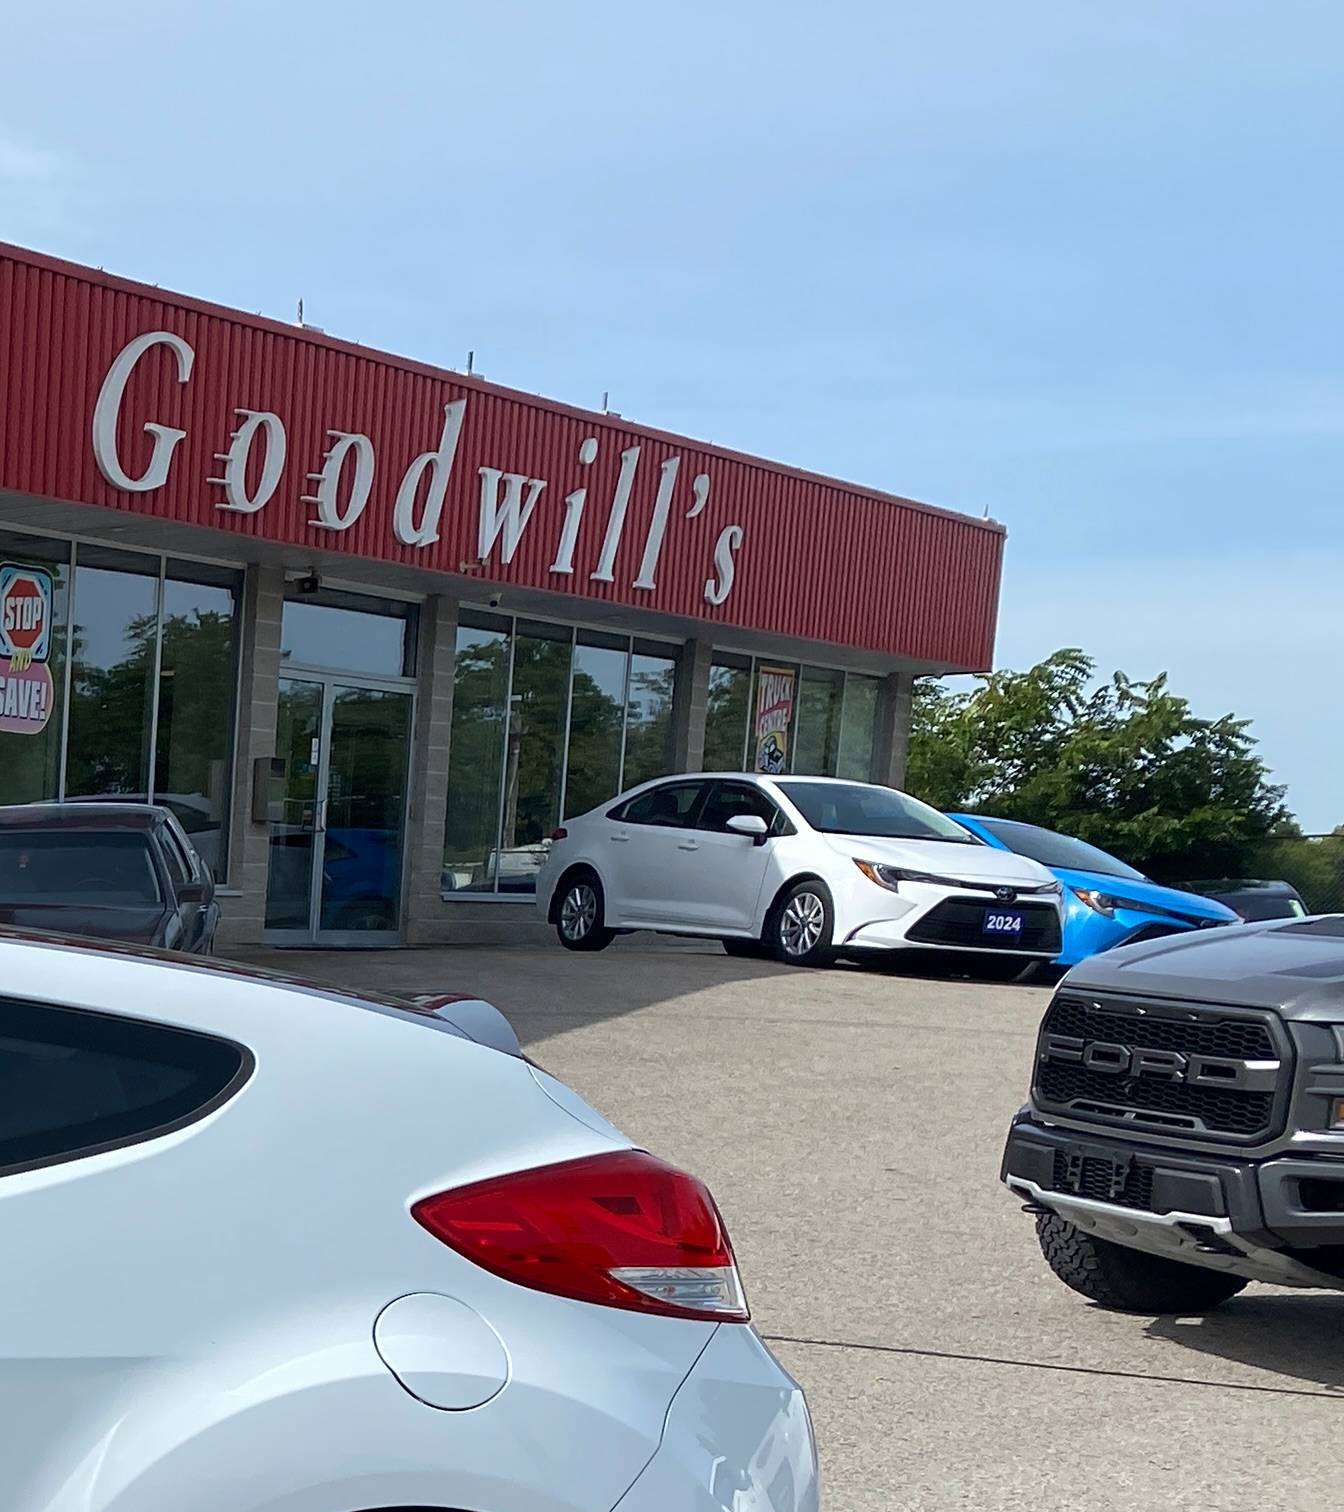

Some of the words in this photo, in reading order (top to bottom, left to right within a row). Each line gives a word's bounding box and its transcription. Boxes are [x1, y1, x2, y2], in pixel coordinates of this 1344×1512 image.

[92, 331, 744, 605] Goodwill's
[4, 596, 44, 632] STOP
[9, 647, 32, 673] AND
[759, 672, 794, 714] TRUCK
[987, 914, 1022, 931] 2024
[1045, 1033, 1250, 1092] FORD
